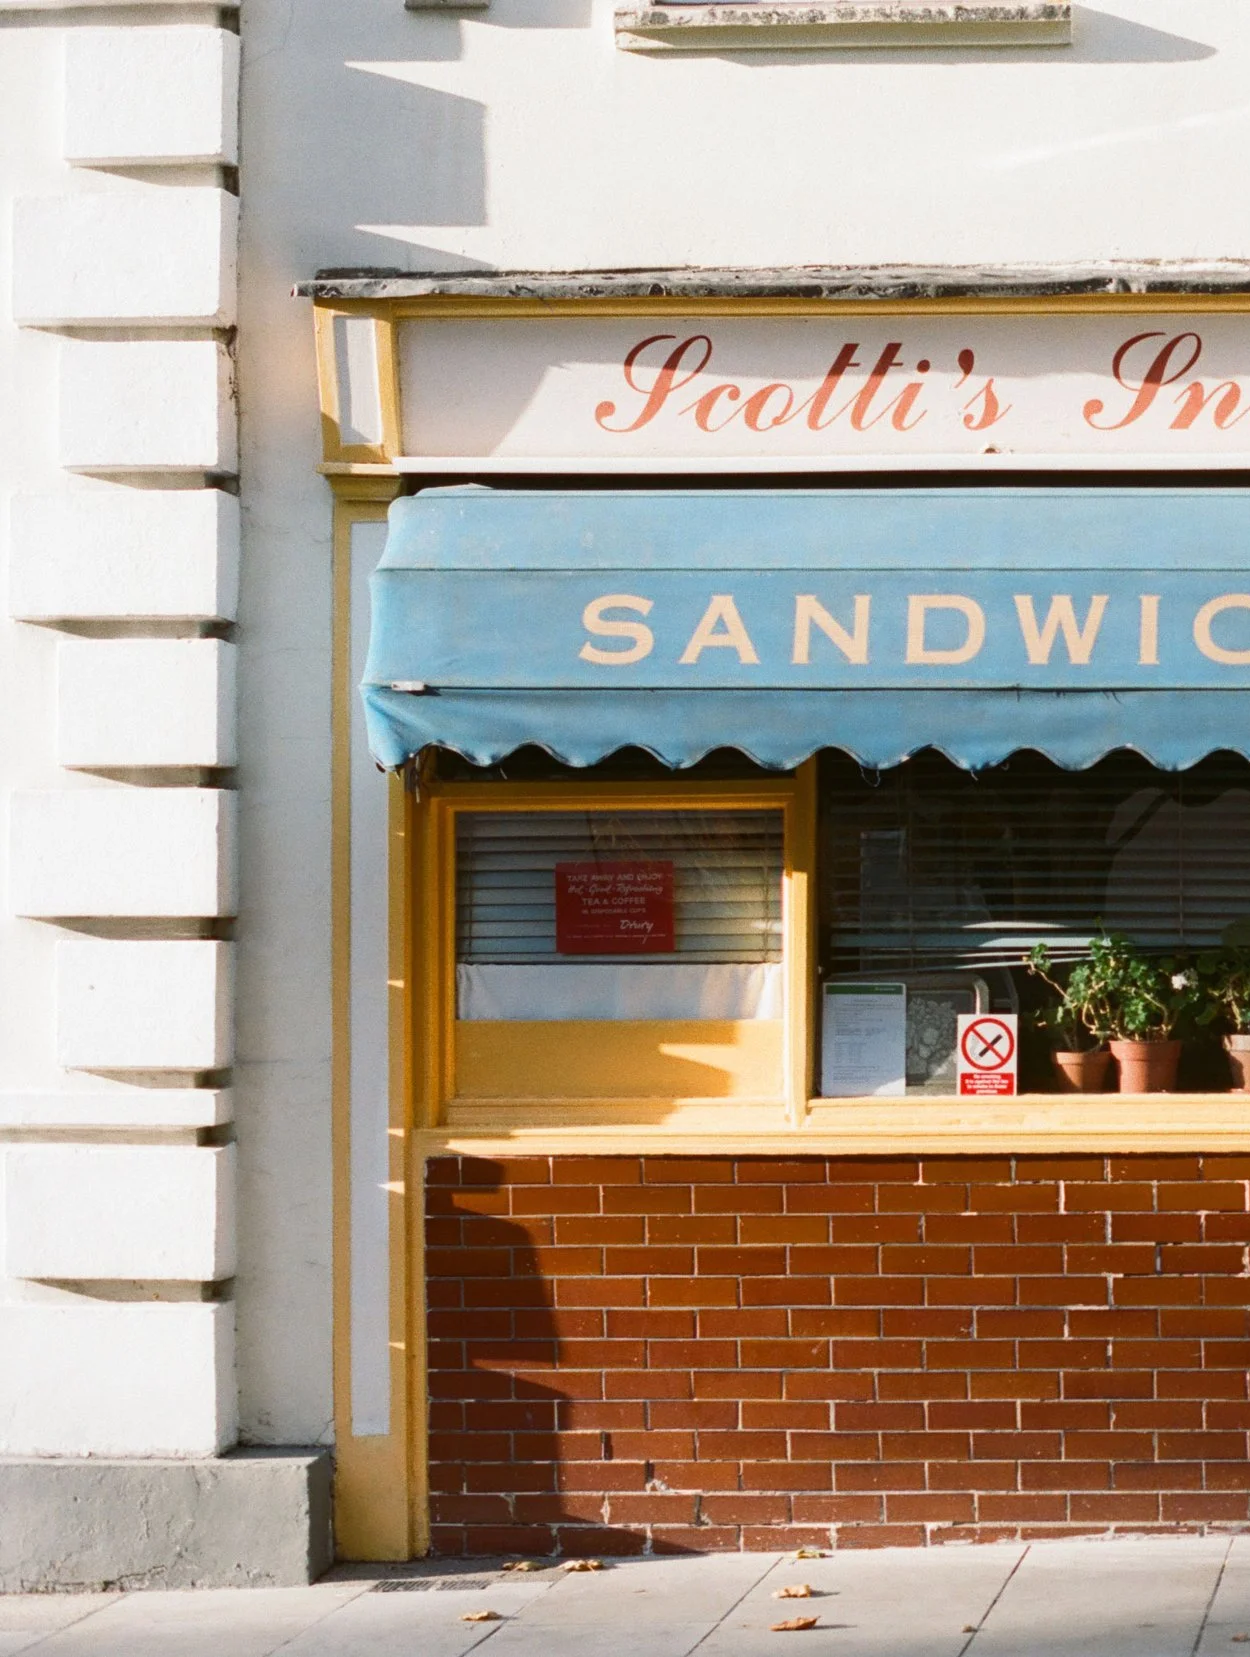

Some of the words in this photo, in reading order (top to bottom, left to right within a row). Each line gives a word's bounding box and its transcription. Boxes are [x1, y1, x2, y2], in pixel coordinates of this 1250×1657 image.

[595, 333, 1013, 433] Scotti's
[616, 873, 634, 881] AND
[582, 897, 600, 906] TEA
[611, 896, 646, 905] COFFEE
